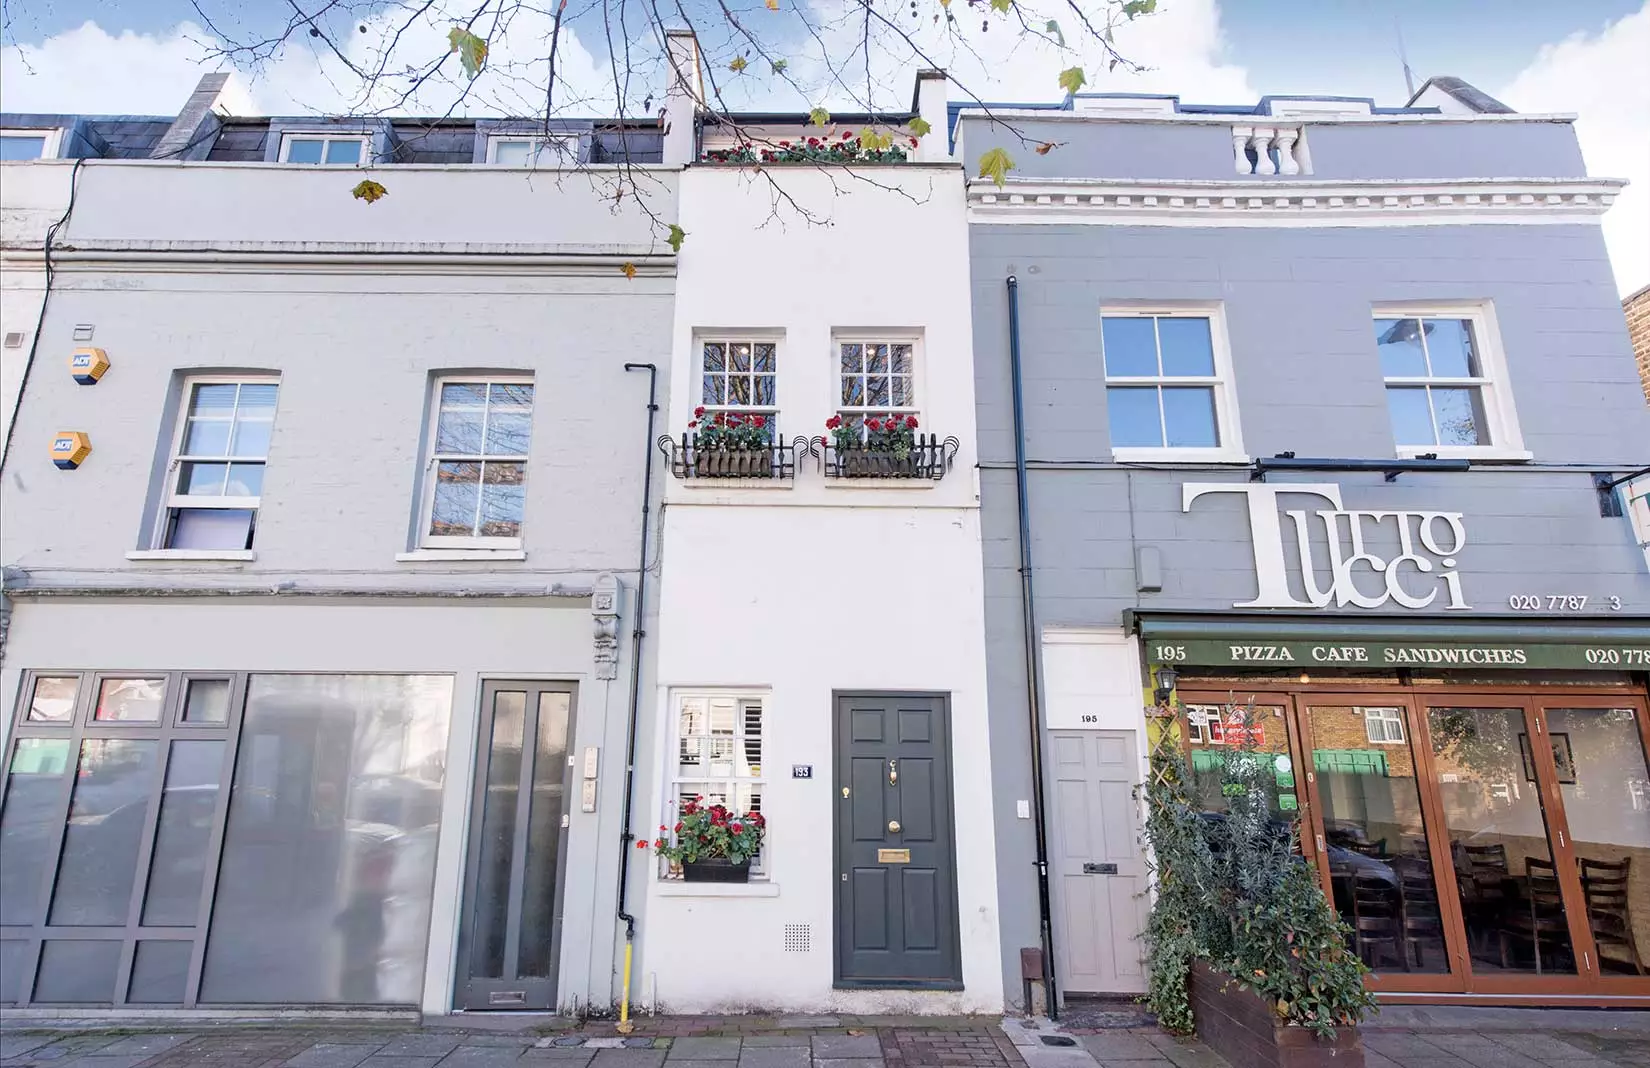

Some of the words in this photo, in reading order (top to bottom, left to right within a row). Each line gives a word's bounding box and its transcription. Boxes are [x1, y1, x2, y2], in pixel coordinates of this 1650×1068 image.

[72, 355, 91, 367] ADT
[52, 439, 73, 451] ADT
[1510, 595, 1541, 610] 020
[1546, 595, 1588, 610] 7787
[1610, 596, 1622, 610] 3
[1156, 646, 1187, 661] 195
[1229, 646, 1295, 661] PIZZA
[1312, 647, 1369, 662] CAFE
[1384, 647, 1527, 664] SANDWICHES
[1585, 649, 1619, 664] 020
[1081, 714, 1098, 723] 195
[795, 766, 809, 777] 193
